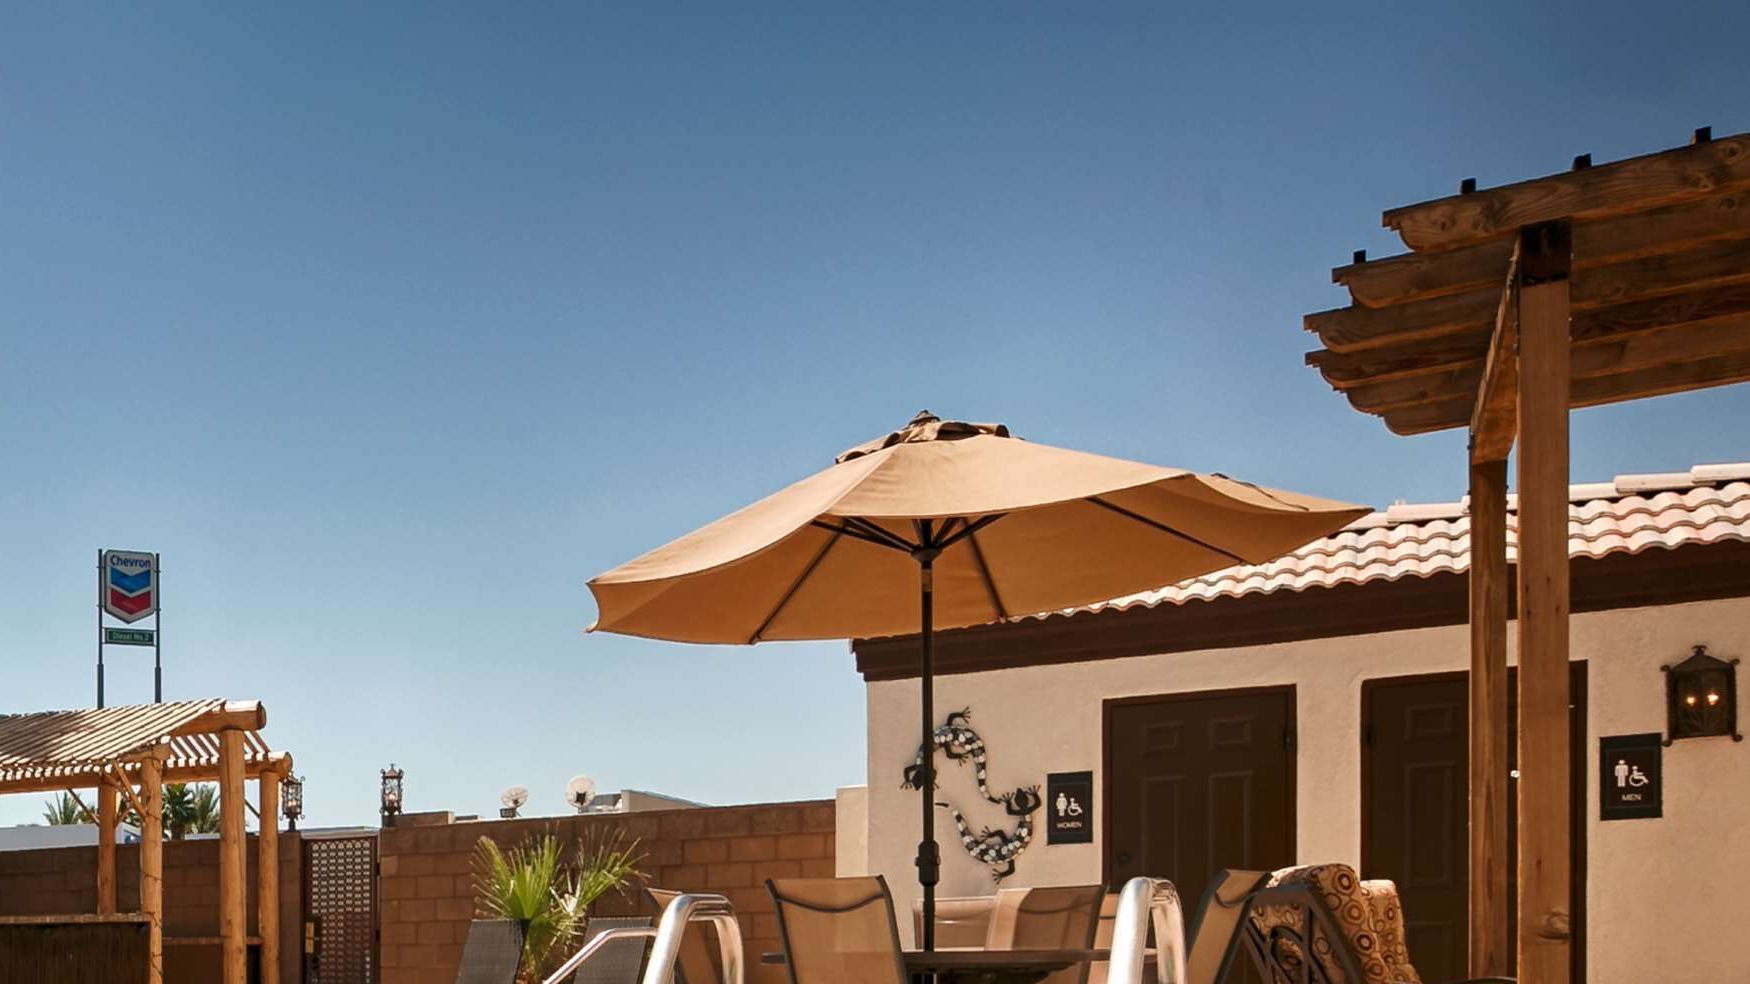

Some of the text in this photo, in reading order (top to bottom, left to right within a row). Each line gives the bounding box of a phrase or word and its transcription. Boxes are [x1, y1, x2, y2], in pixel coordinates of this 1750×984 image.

[110, 554, 151, 569] Chevron
[112, 631, 132, 641] Diesel
[1621, 793, 1642, 802] MEN
[1056, 820, 1082, 829] WOMEN
